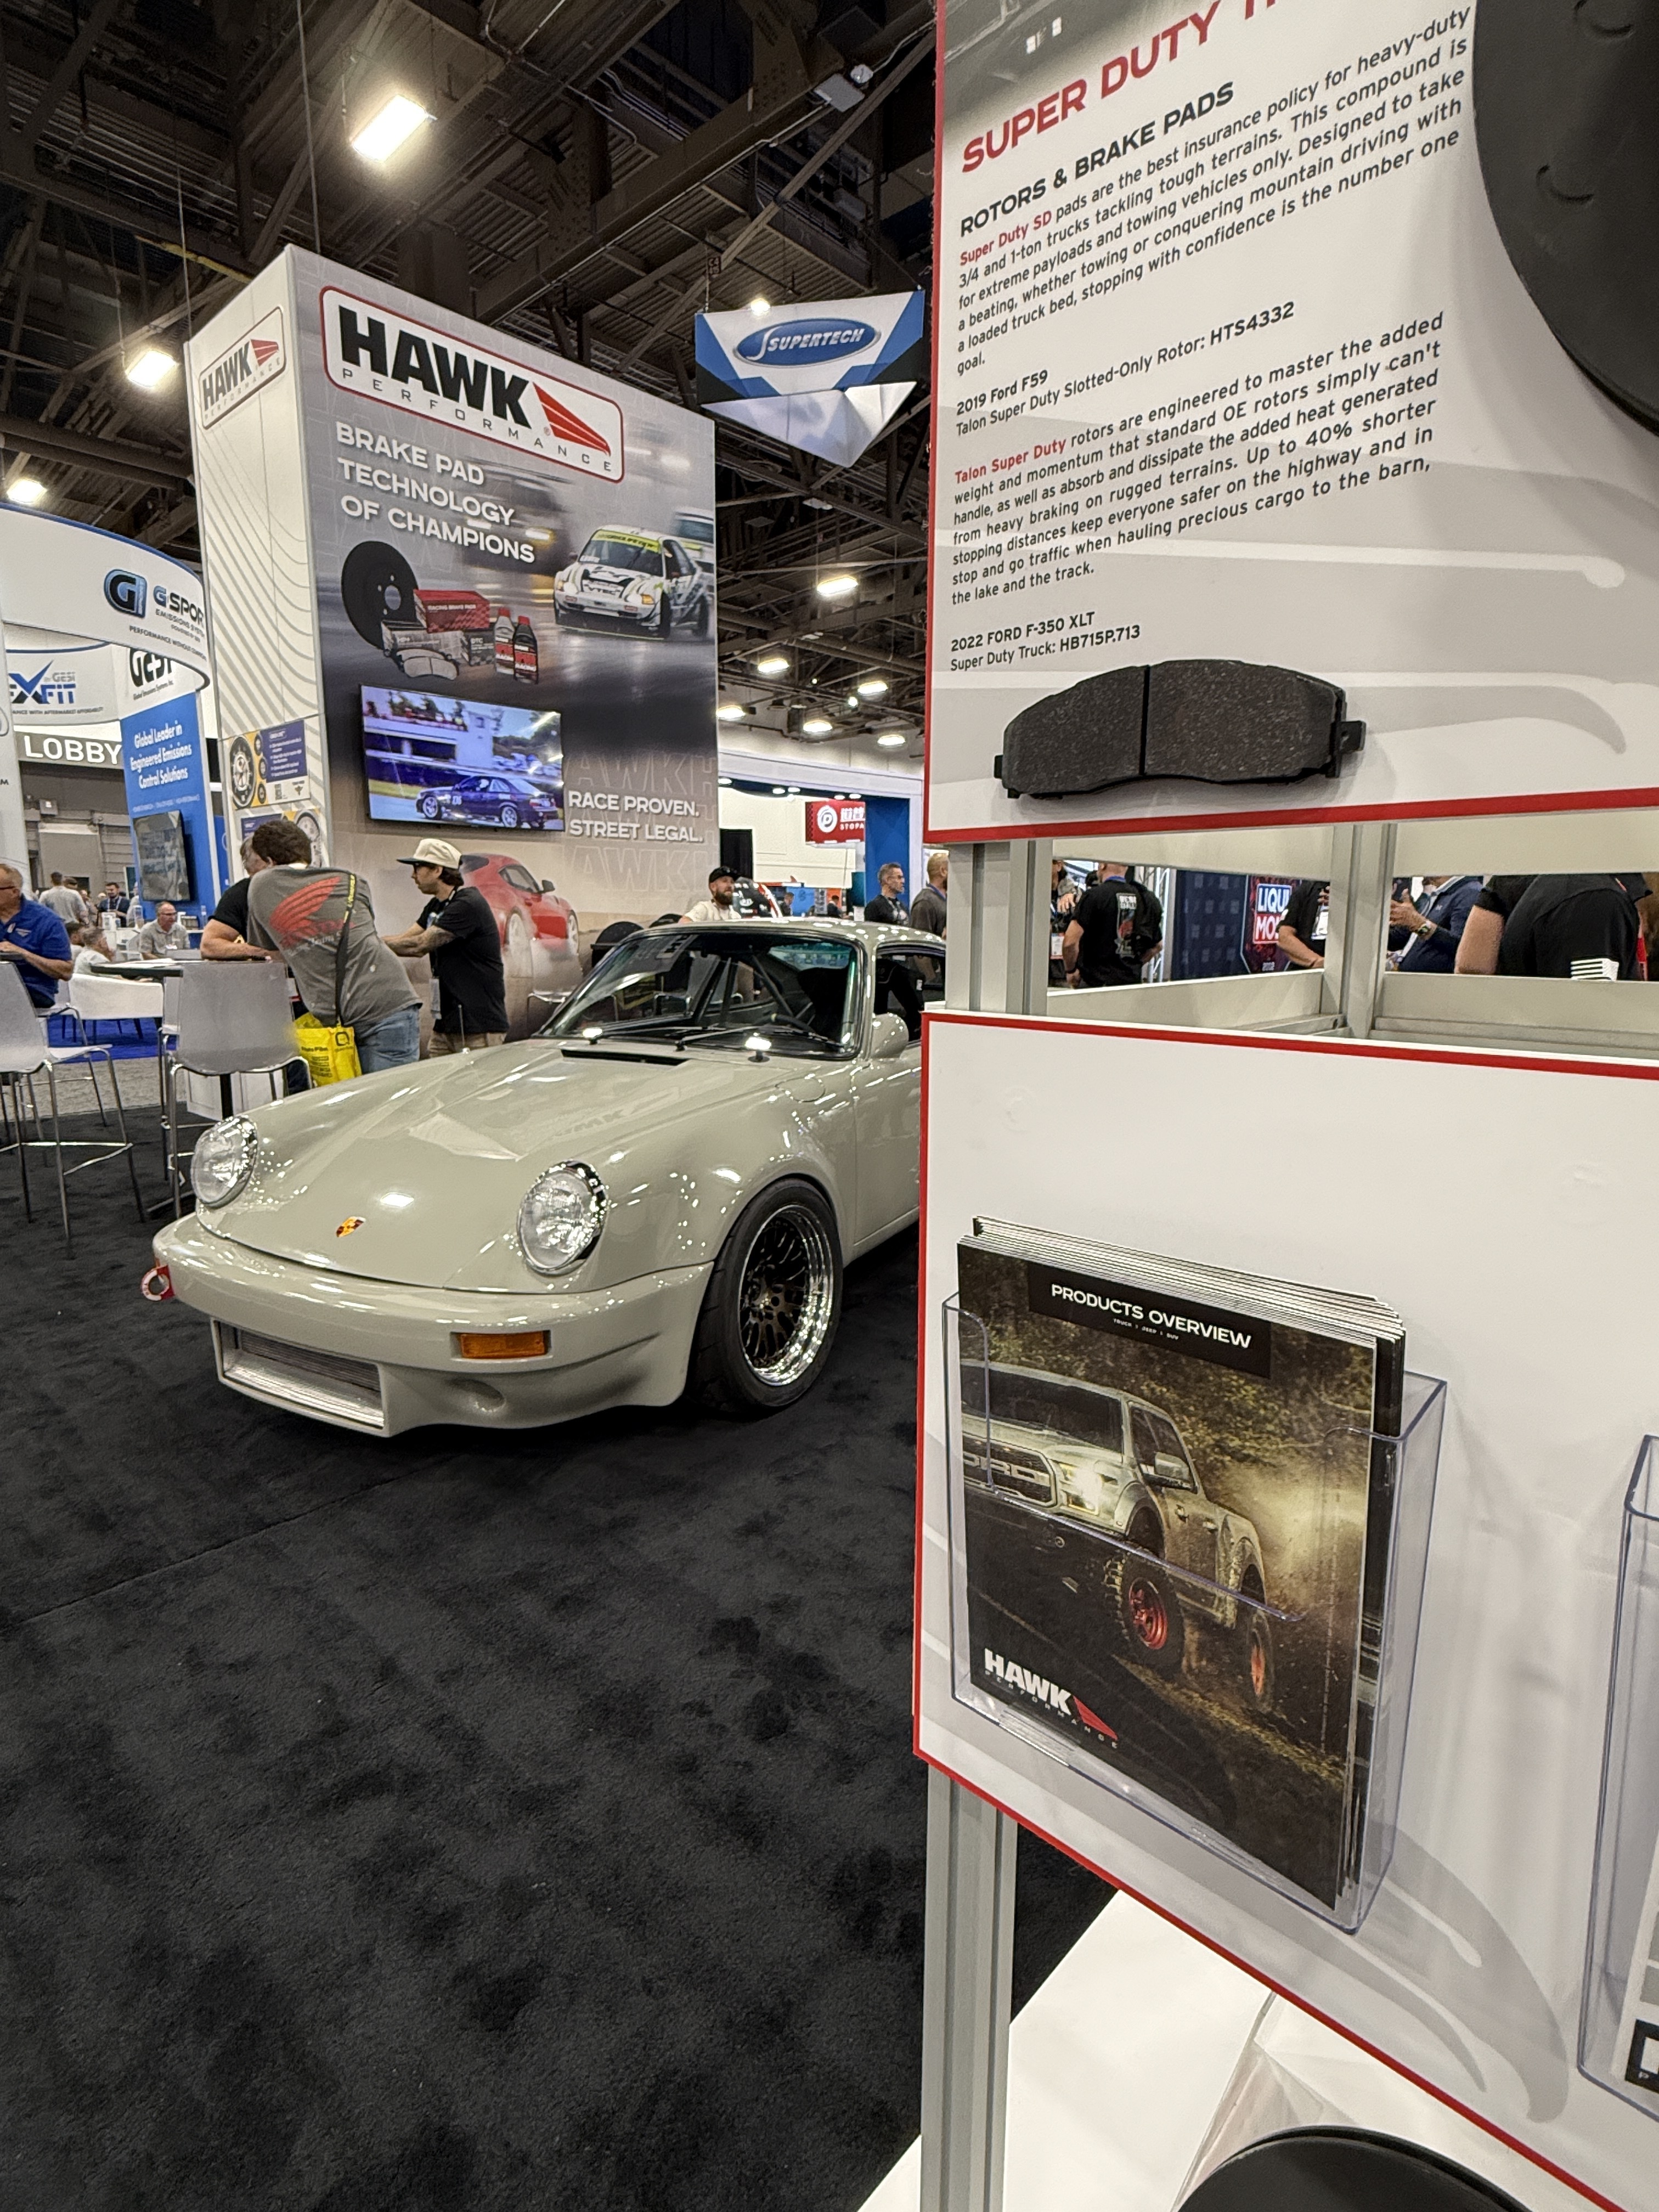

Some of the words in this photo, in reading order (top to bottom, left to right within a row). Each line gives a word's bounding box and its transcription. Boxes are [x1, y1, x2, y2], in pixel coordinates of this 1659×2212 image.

[962, 79, 1087, 173] SUPER
[1101, 0, 1221, 99] DUTY
[959, 267, 979, 289] 3/4
[983, 253, 1006, 277] and
[1011, 240, 1041, 264] 1-ton
[1047, 217, 1090, 247] trucks
[1095, 187, 1153, 224] tackling
[1159, 161, 1204, 194] tough
[1211, 128, 1282, 170] terrains.
[1290, 105, 1328, 132] This
[1336, 46, 1441, 111] compound
[1449, 38, 1467, 59] is
[960, 240, 995, 266] Super
[998, 223, 1029, 248] Duty
[1033, 210, 1052, 231] SD
[1056, 195, 1087, 224] pads
[1091, 182, 1114, 202] are
[1118, 168, 1142, 190] the
[1147, 147, 1179, 176] best
[1184, 110, 1261, 159] insurance
[1267, 81, 1319, 122] policy
[1324, 65, 1352, 91] for
[1357, 6, 1471, 75] heavy-duty
[960, 178, 1046, 238] ROTORS
[1053, 168, 1068, 189] &
[1075, 120, 1155, 180] BRAKE
[1163, 81, 1233, 136] PADS
[958, 319, 965, 331] a
[969, 297, 1018, 327] beating,
[1022, 269, 1076, 303] whether
[1081, 247, 1128, 278] towing
[1133, 237, 1149, 255] or
[1154, 196, 1243, 245] conquering
[1249, 157, 1333, 205] mountain
[1340, 123, 1409, 165] driving
[1417, 98, 1463, 131] with
[959, 292, 976, 310] for
[979, 269, 1030, 301] extreme
[1033, 239, 1092, 280] payloads
[1096, 222, 1122, 247] and
[1126, 201, 1177, 234] towing
[1181, 169, 1248, 208] vehicles
[1252, 148, 1293, 177] only.
[1299, 100, 1386, 157] Designed
[1392, 94, 1412, 114] to
[1419, 70, 1464, 102] take
[338, 304, 532, 430] HAWK
[767, 328, 865, 352] SUPERTECH
[956, 416, 986, 436] Talon
[990, 402, 1026, 425] Super
[1030, 389, 1060, 410] Duty
[1064, 356, 1153, 398] Slotted-Only
[1157, 336, 1205, 365] Rotor:
[1210, 301, 1294, 346] HTS4332
[202, 340, 252, 411] HAWK
[955, 465, 986, 484] Talon
[991, 451, 1029, 473] Super
[1034, 439, 1066, 460] Duty
[1071, 424, 1114, 448] rotors
[1119, 414, 1143, 432] are
[1148, 378, 1239, 422] engineered
[1244, 374, 1262, 391] to
[1268, 351, 1334, 384] master
[1340, 339, 1372, 360] the
[1379, 311, 1443, 348] added
[956, 393, 986, 416] 2019
[990, 380, 1018, 403] Ford
[1022, 369, 1048, 392] F59
[336, 421, 428, 469] BRAKE
[436, 453, 484, 486] PAD
[343, 368, 612, 472] PERFORMANCE
[955, 481, 994, 505] weight
[998, 472, 1022, 492] and
[1027, 450, 1103, 483] momentum
[1109, 435, 1140, 458] that
[1146, 410, 1216, 447] standard
[1223, 400, 1247, 422] OE
[1254, 385, 1308, 414] rotors
[1316, 362, 1381, 394] simply
[1389, 340, 1441, 371] can't
[337, 457, 515, 526] TECHNOLOGY
[952, 543, 1002, 566] stopping
[1007, 526, 1066, 552] distances
[1071, 517, 1103, 535] keep
[1108, 498, 1175, 525] everyone
[1180, 484, 1221, 506] safer
[1226, 478, 1246, 494] on
[1252, 469, 1280, 487] the
[1287, 447, 1362, 478] highway
[1369, 431, 1406, 457] and
[1414, 427, 1432, 445] in
[953, 528, 981, 545] from
[986, 516, 1024, 537] heavy
[1029, 501, 1079, 524] braking
[1085, 494, 1102, 509] on
[1109, 474, 1162, 503] rugged
[1169, 458, 1238, 486] terrains.
[1246, 446, 1269, 465] Up
[1278, 439, 1296, 456] to
[1305, 420, 1352, 447] 40%
[1362, 399, 1436, 432] shorter
[341, 495, 380, 521] OF
[387, 507, 535, 563] CHAMPIONS
[169, 592, 204, 627] SPOR
[951, 634, 983, 652] 2022
[987, 627, 1022, 645] FORD
[1026, 617, 1065, 637] F-350
[1069, 611, 1095, 630] XLT
[950, 656, 984, 672] Super
[987, 649, 1015, 665] Duty
[1018, 641, 1056, 659] Truck:
[1060, 624, 1140, 652] HB715P.713
[24, 735, 122, 765] LOBBY
[129, 748, 162, 773] Engineered
[162, 742, 192, 761] Emissions
[134, 727, 154, 749] Global
[154, 723, 176, 742] Leader
[138, 769, 160, 789] Control
[160, 765, 188, 785] Solutions
[568, 790, 619, 811] RACE
[624, 795, 699, 817] PROVEN.
[569, 819, 641, 838] STREET
[645, 823, 704, 843] LEGAL.
[1051, 1283, 1144, 1319] PRODUCTS
[1148, 1310, 1252, 1348] OVERVIEW
[984, 1647, 1072, 1716] HAWK
